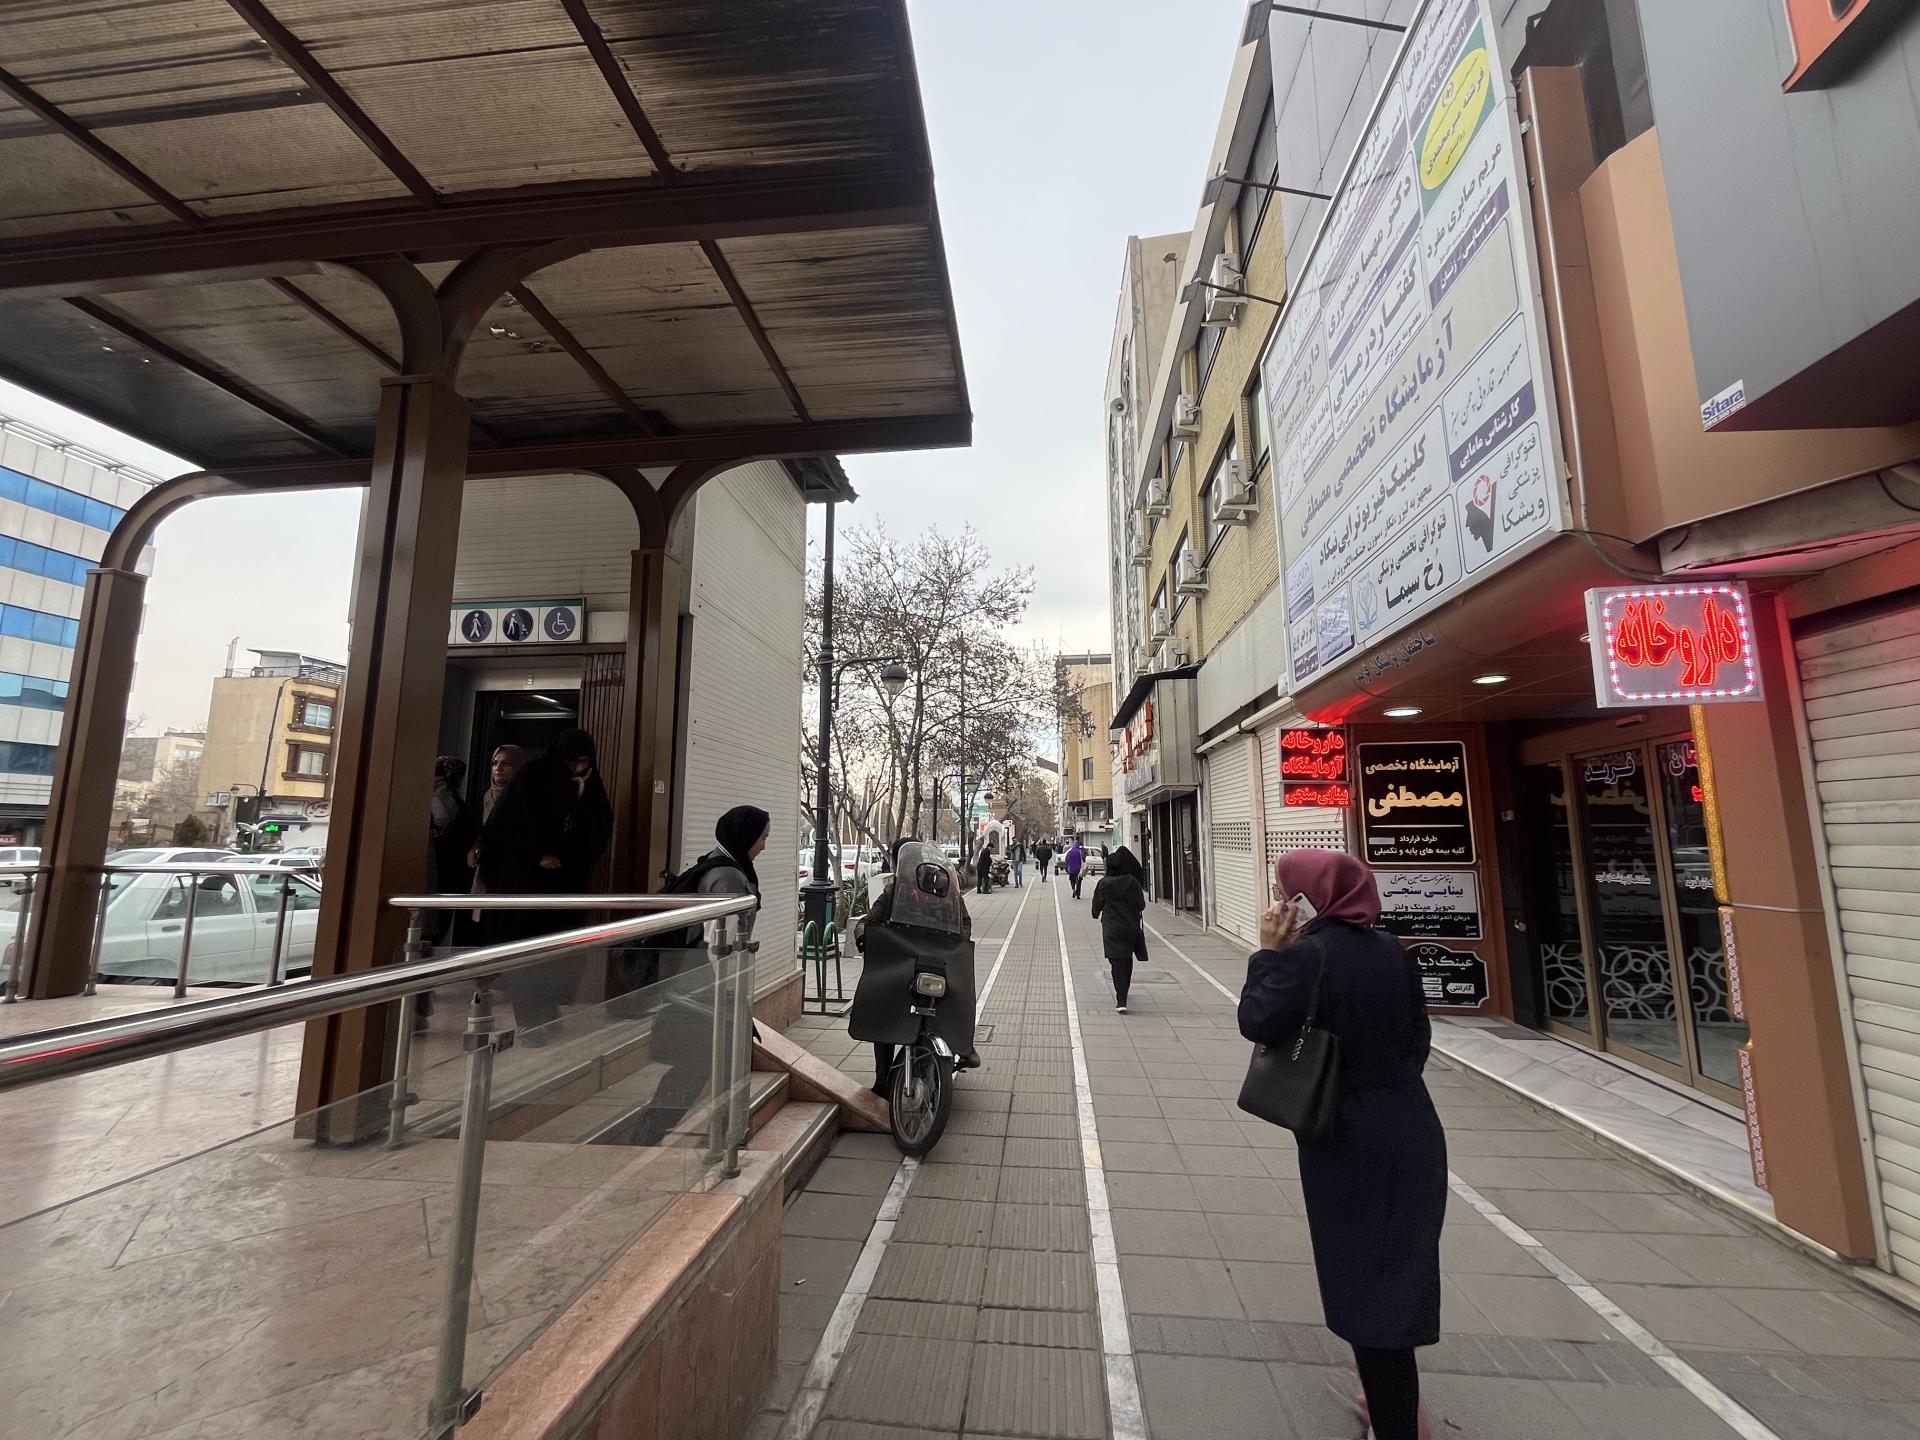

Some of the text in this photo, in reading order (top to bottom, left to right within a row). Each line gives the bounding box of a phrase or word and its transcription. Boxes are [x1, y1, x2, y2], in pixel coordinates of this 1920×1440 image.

[1437, 18, 1467, 79] Borhani
[1462, 67, 1484, 109] فرشته
[1477, 142, 1501, 188] مریم
[1386, 174, 1411, 239] دکتر
[1446, 178, 1475, 233] صابری
[1360, 228, 1383, 273] مهسا
[1426, 226, 1445, 259] مفرد
[1327, 270, 1360, 339] منصوری
[1378, 306, 1453, 434] آزمایشگاه
[1497, 342, 1522, 386] معصومه
[1703, 390, 1744, 420] Sitara
[1459, 396, 1520, 469] کارشناس مامایی
[1333, 415, 1376, 498] تخصصی
[1385, 432, 1426, 498] کلینیک
[1498, 432, 1536, 480] فتوگرافی
[1507, 466, 1541, 502] پزشکی
[1300, 483, 1331, 539] مصطفی
[1337, 477, 1386, 554] فیزیوتراپی
[1500, 496, 1545, 533] ویشکا
[1417, 512, 1446, 553] فتوگرافی
[1377, 558, 1394, 585] پزشکی
[1384, 575, 1420, 609] سیما
[1616, 596, 1742, 687] داروخانه
[1282, 731, 1345, 754] داروخانه
[1282, 755, 1345, 779] آزمایشگاه
[1365, 757, 1459, 775] آزمایشگاه تخصصی
[1584, 752, 1636, 784] فرید
[1285, 785, 1349, 805] بینایی سنجی
[1368, 783, 1463, 817] مصطفی
[1374, 847, 1398, 857] تکمیلی
[1399, 835, 1438, 844] طرف قرارداد
[1404, 847, 1418, 857] پایه
[1419, 847, 1434, 856] های
[1435, 847, 1450, 856] بیمه
[1451, 847, 1465, 856] کلیه
[1383, 883, 1463, 898] بینایی سنجی
[1435, 956, 1474, 970] عینک
